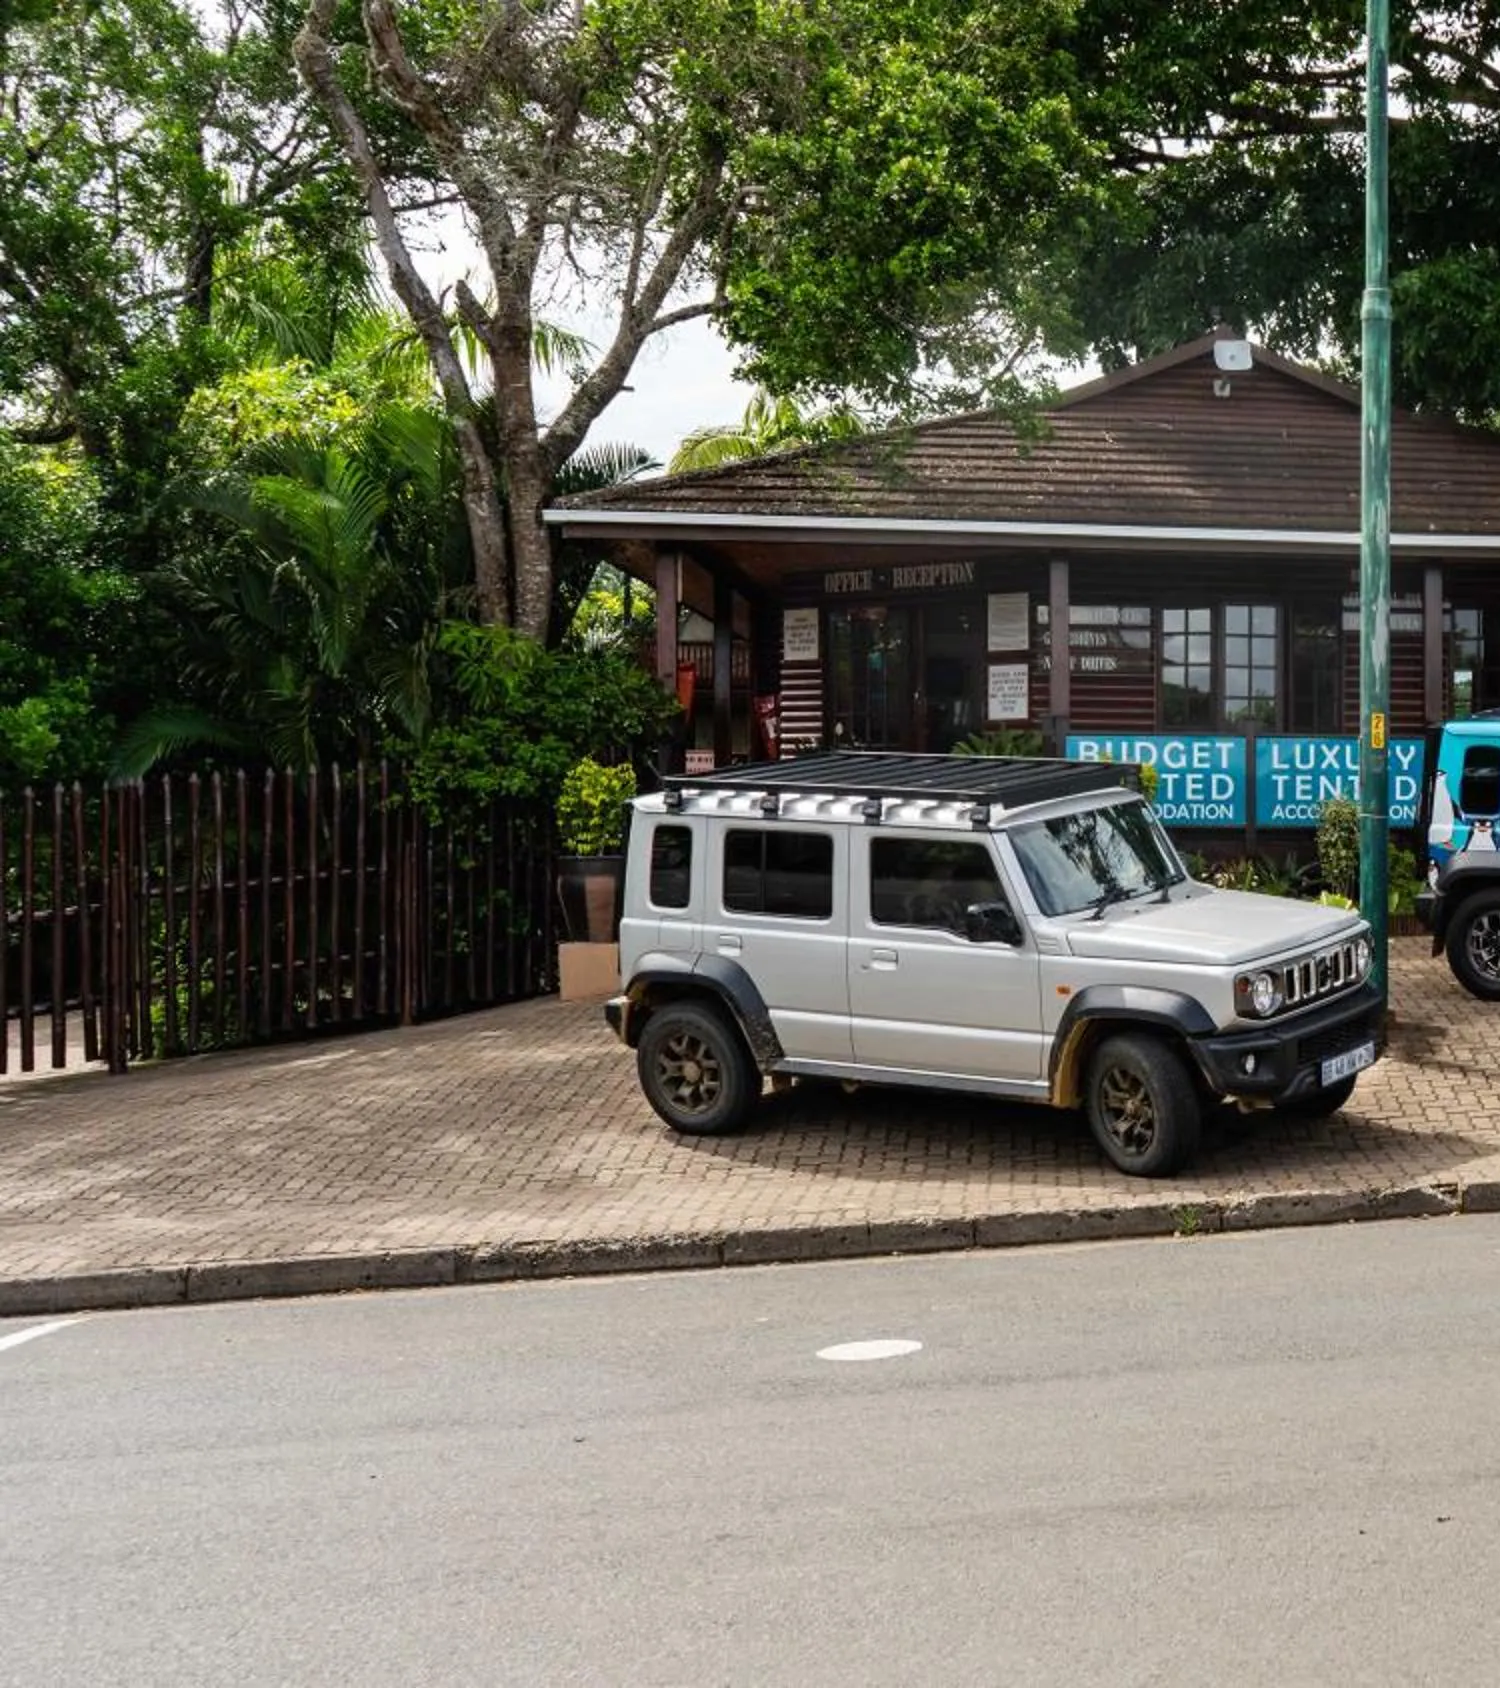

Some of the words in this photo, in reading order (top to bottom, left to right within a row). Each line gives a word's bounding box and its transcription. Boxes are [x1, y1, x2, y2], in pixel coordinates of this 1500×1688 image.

[824, 570, 873, 593] OFFICE
[892, 561, 975, 589] RECEPTION
[1078, 741, 1235, 769] BUDGET
[1271, 743, 1416, 770] LUXUY
[1160, 773, 1235, 801] TED
[1271, 775, 1417, 801] TENTD
